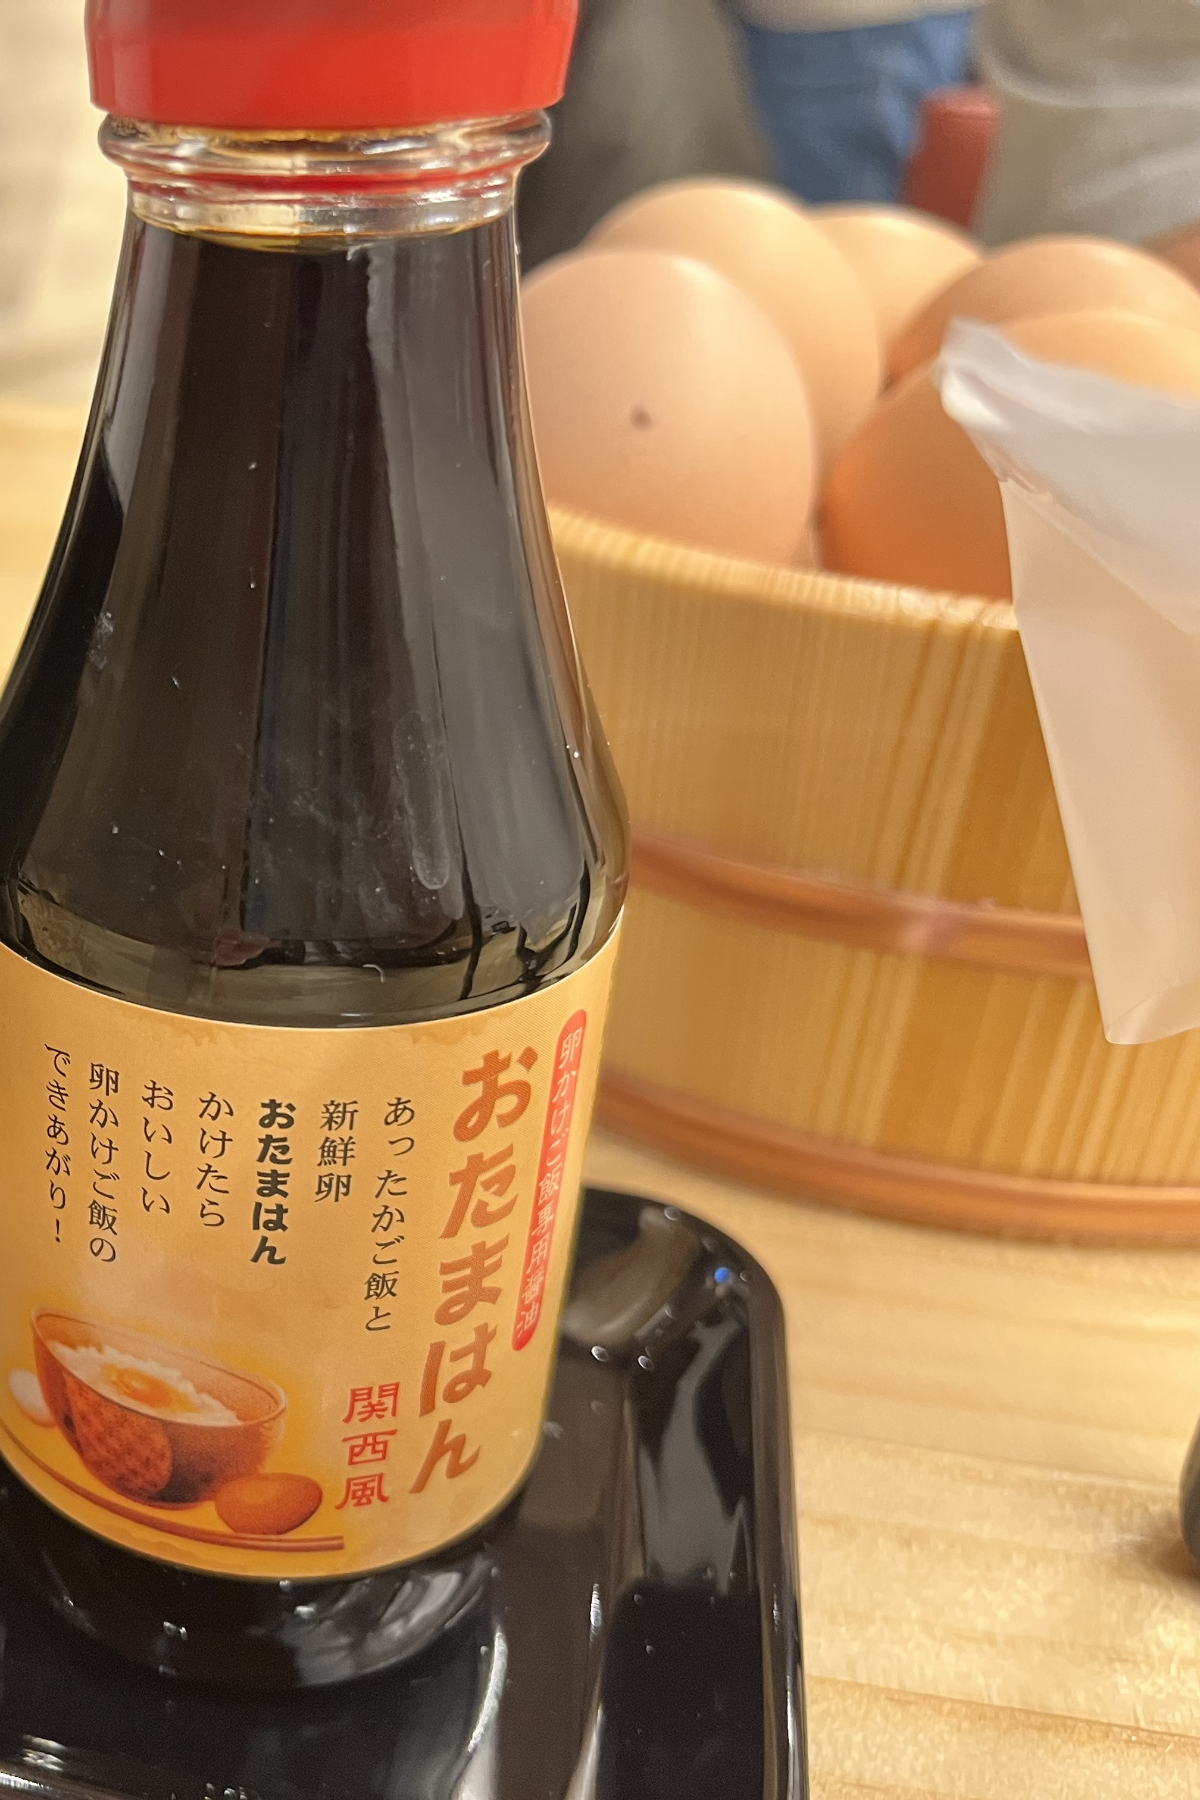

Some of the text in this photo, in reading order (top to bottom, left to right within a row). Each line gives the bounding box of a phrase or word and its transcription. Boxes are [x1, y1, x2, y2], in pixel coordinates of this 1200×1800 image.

[87, 1061, 121, 1263] 卵かけご飯の
[141, 1079, 175, 1215] おいしい
[195, 1090, 235, 1228] かけたら
[249, 1098, 297, 1266] おたまはん
[313, 1099, 360, 1203] 新鮮卵
[363, 1096, 416, 1332] あったかご飯と
[516, 1026, 583, 1339] 卵かけご飯専用醤油
[409, 1045, 539, 1495] おたまはん
[334, 1380, 401, 1510] 関西風
